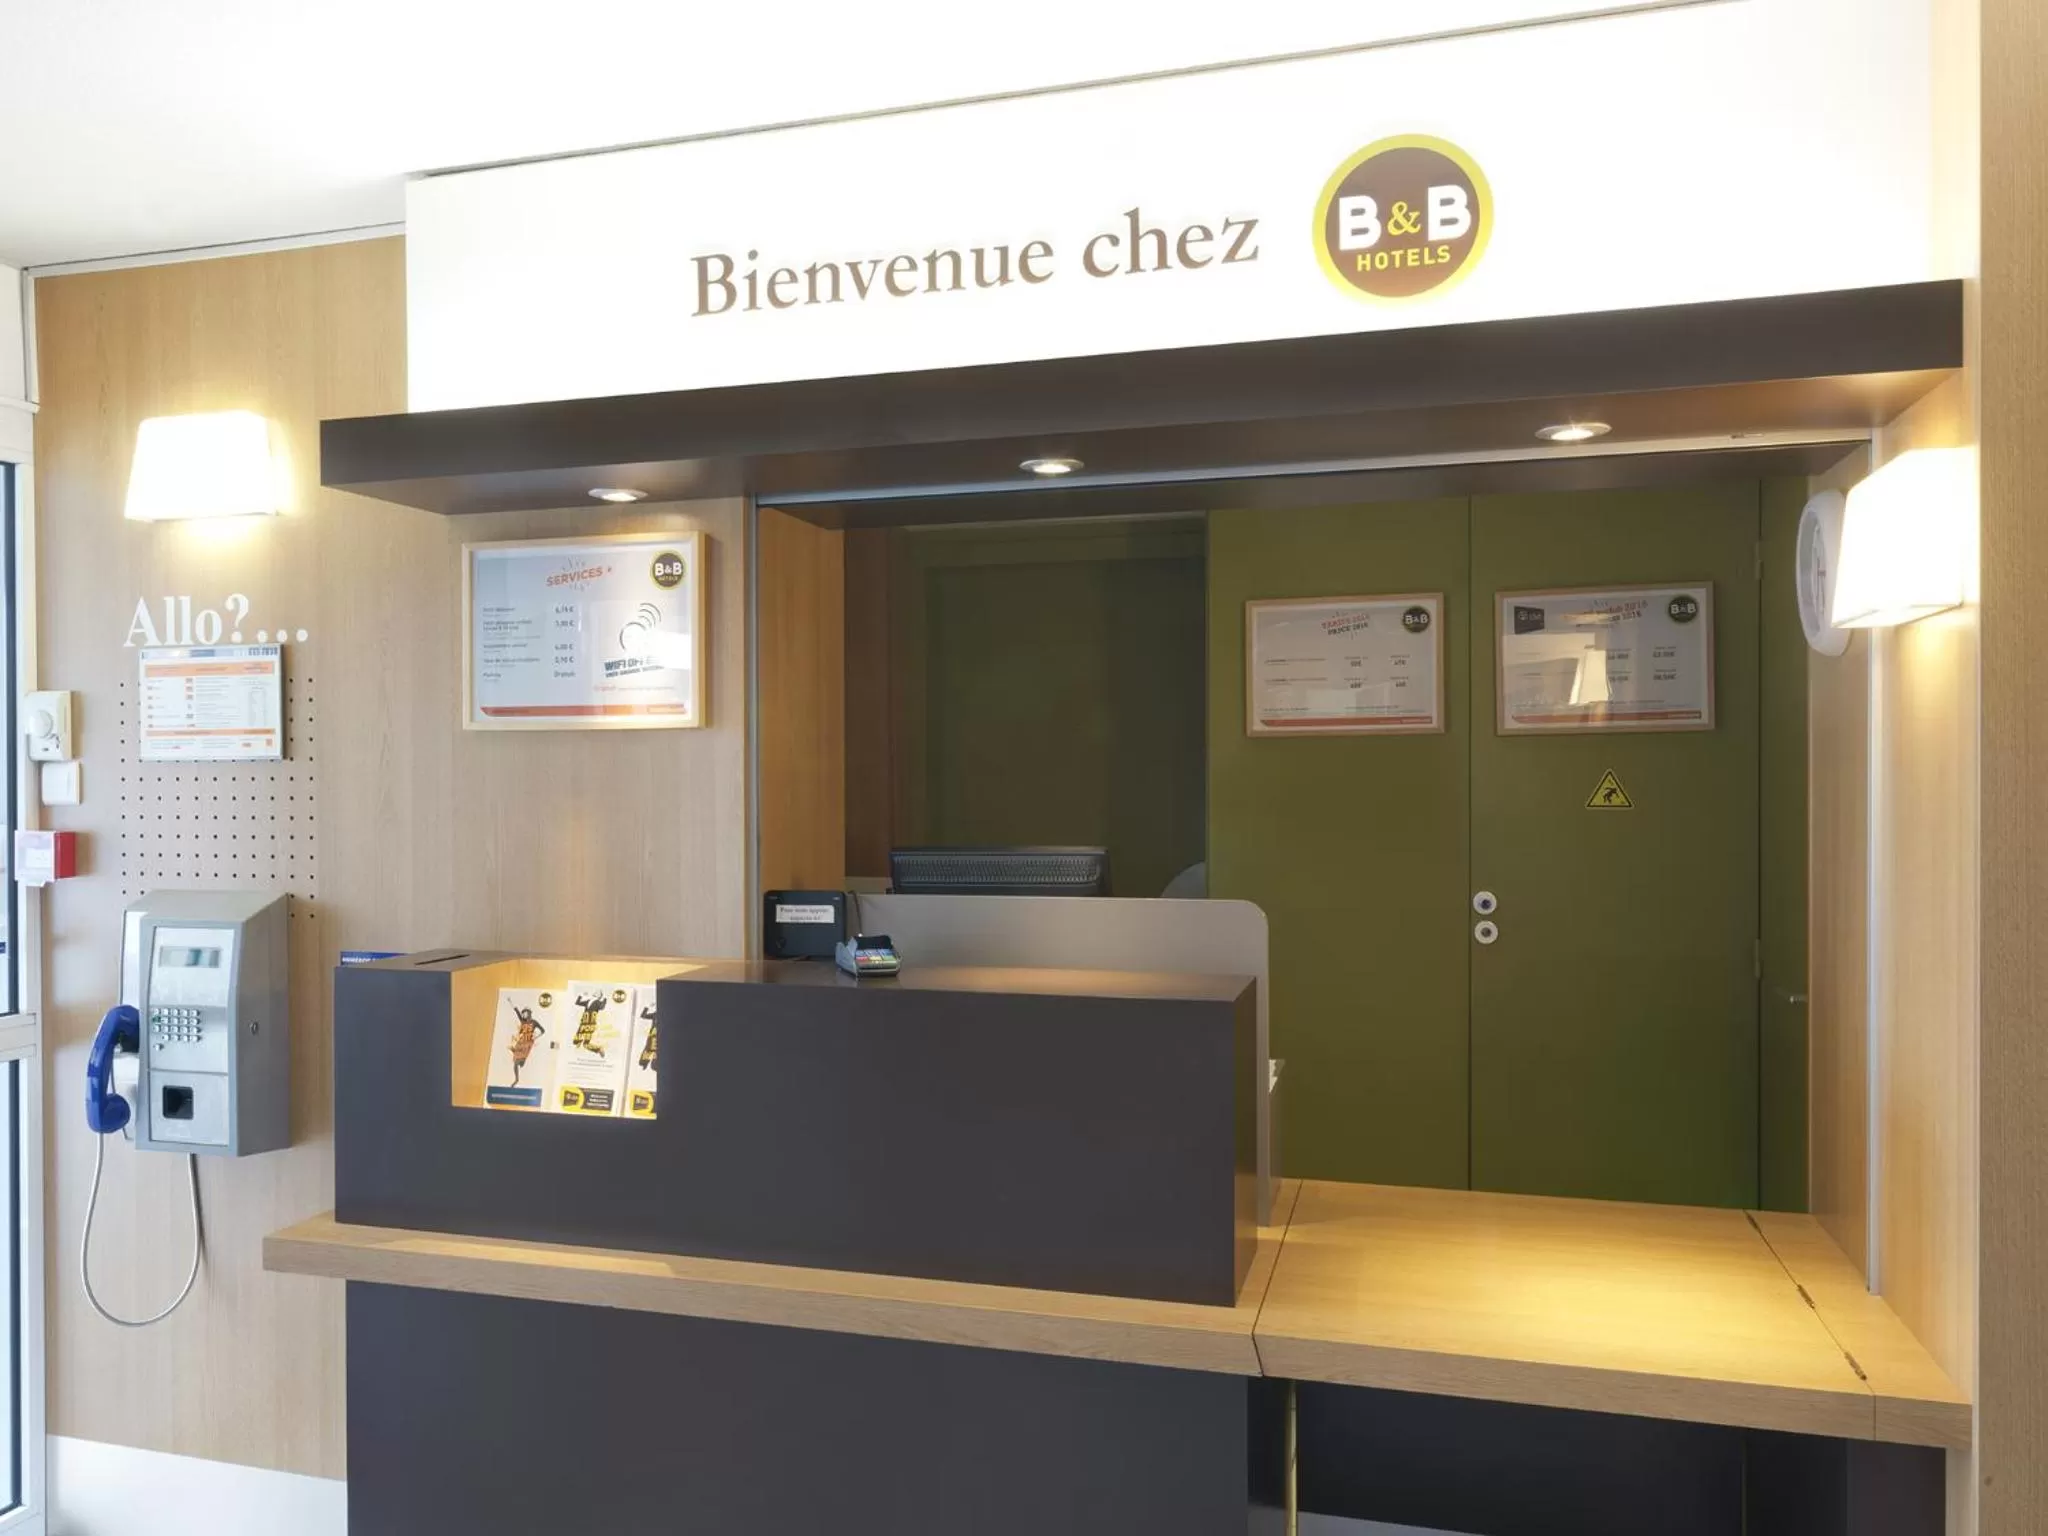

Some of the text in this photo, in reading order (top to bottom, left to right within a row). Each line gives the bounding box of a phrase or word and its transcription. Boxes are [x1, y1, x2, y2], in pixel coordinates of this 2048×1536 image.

[1339, 184, 1472, 250] B&B
[690, 206, 1260, 317] Bienvenue chez
[1357, 245, 1451, 272] HOTELS
[546, 566, 603, 587] SERVICES
[655, 561, 682, 576] B&B
